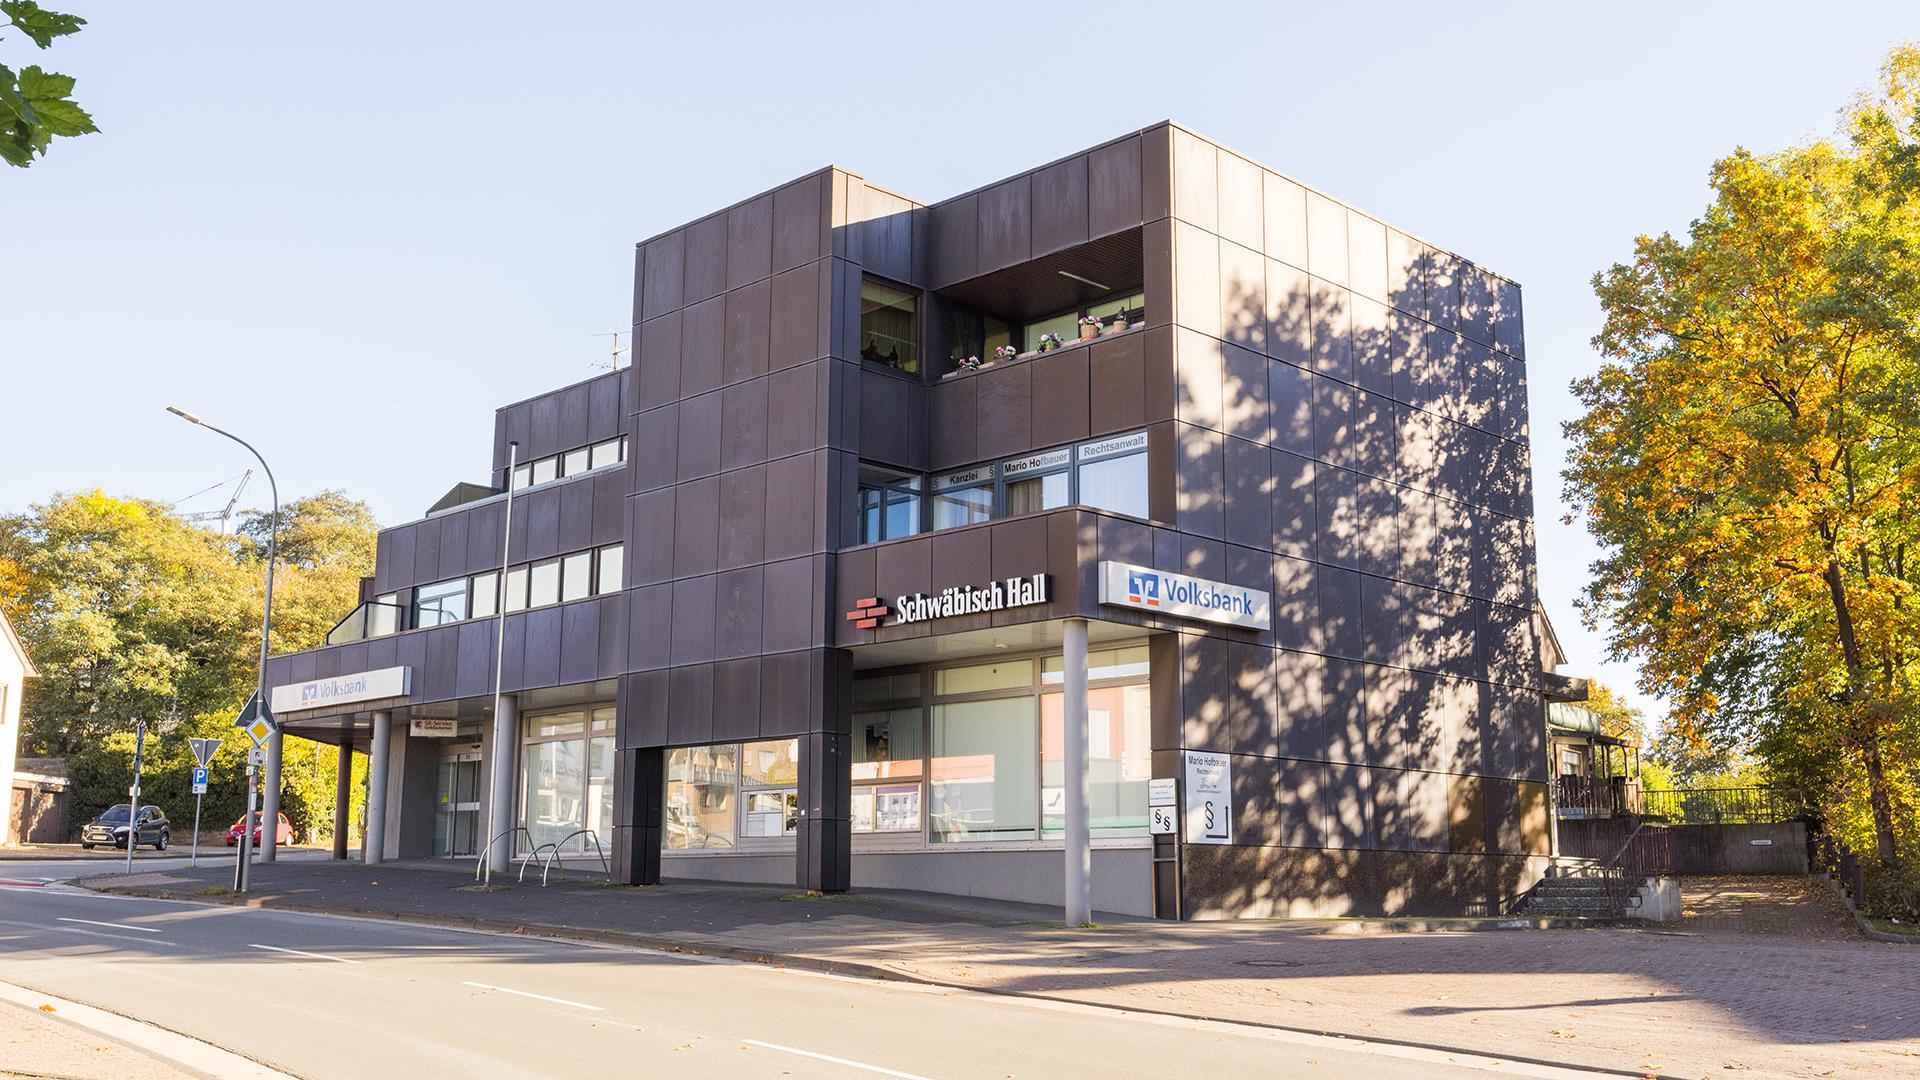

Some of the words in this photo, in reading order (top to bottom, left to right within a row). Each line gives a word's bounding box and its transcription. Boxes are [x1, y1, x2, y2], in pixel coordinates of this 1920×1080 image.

[1084, 435, 1145, 457] Rechtsanwalt
[1004, 461, 1028, 473] Mario
[1029, 452, 1068, 469] Hofbauer
[950, 472, 978, 486] Kanzlei
[897, 582, 1003, 624] Schwäbisch
[1007, 573, 1047, 608] Hall
[1164, 578, 1252, 616] Volksbank
[319, 676, 367, 698] Volksbank
[1188, 755, 1203, 766] Mario
[1204, 757, 1227, 767] Hofbauer
[196, 770, 205, 782] P
